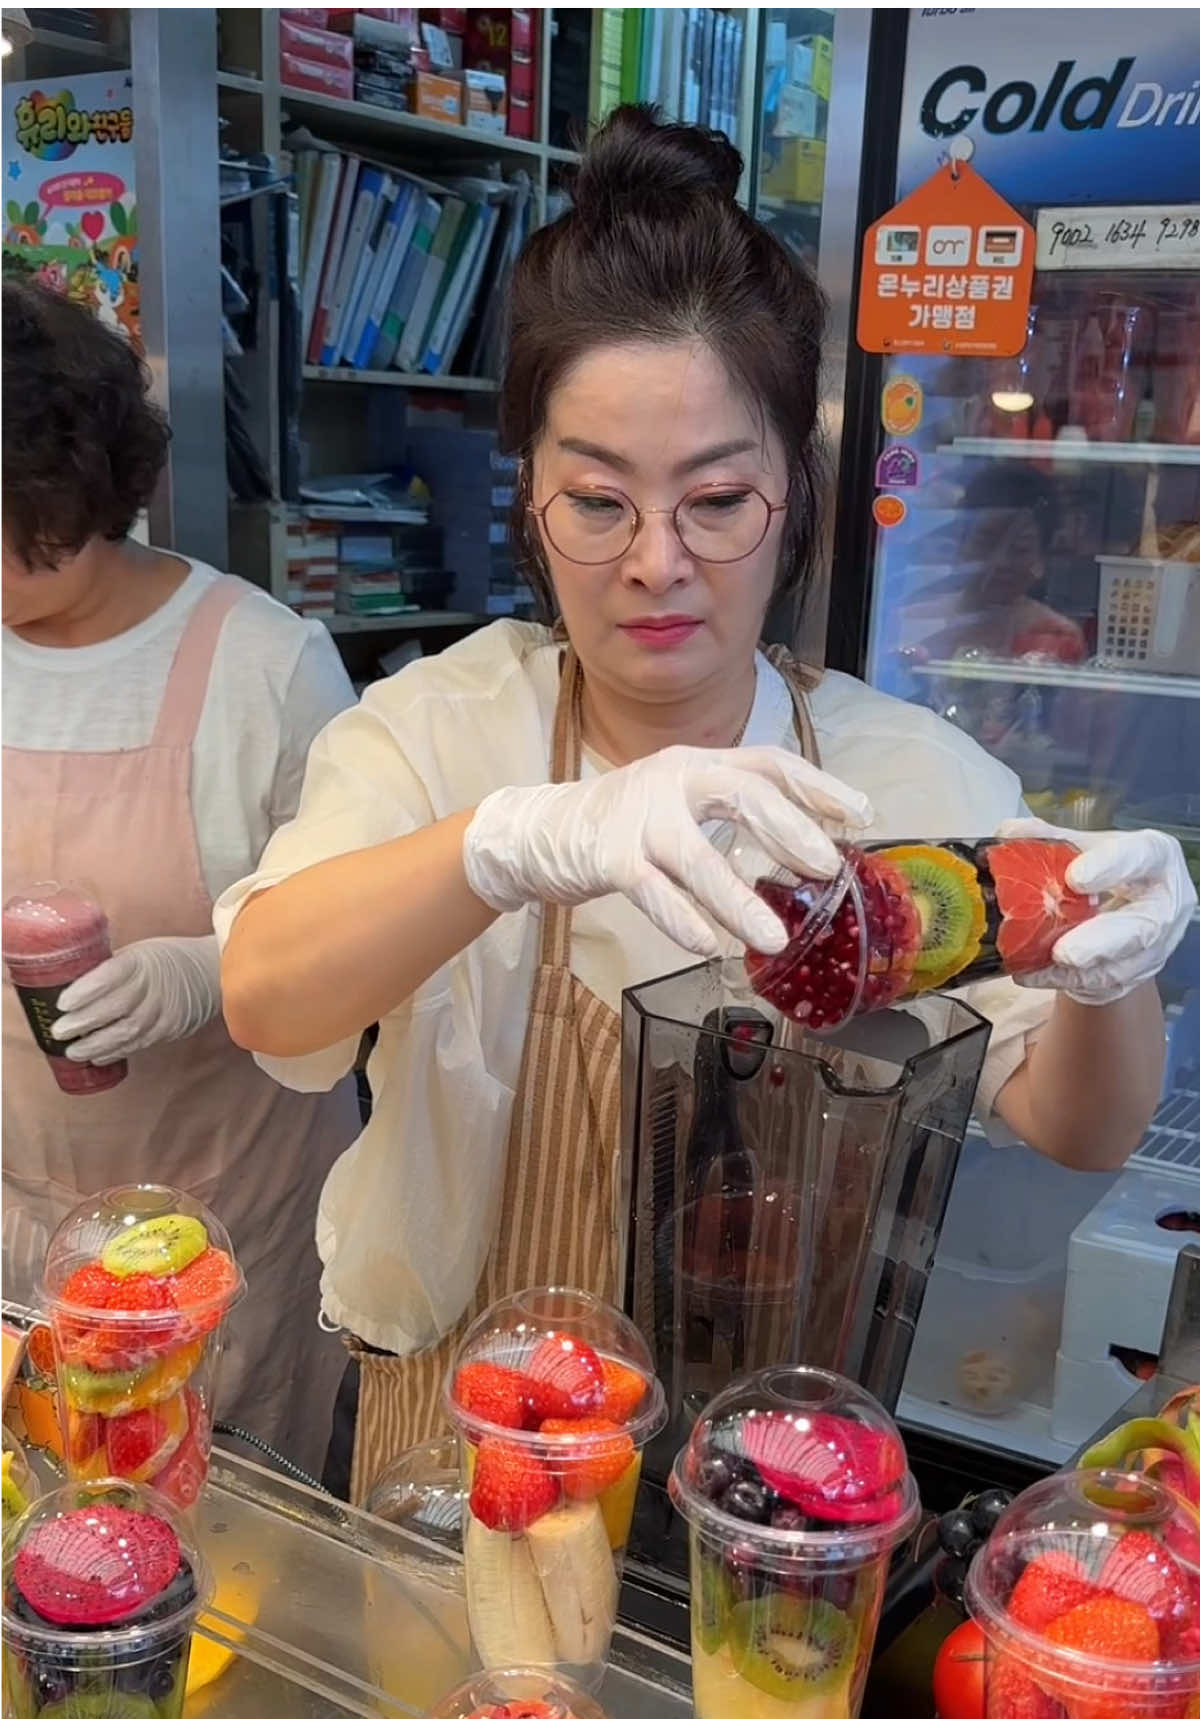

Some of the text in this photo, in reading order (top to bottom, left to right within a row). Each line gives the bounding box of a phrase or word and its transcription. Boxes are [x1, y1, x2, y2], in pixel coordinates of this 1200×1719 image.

[919, 56, 1136, 139] Cold
[1105, 219, 1146, 249] 1634
[877, 273, 1014, 300] 온누리상품권
[908, 304, 976, 330] 가맹점
